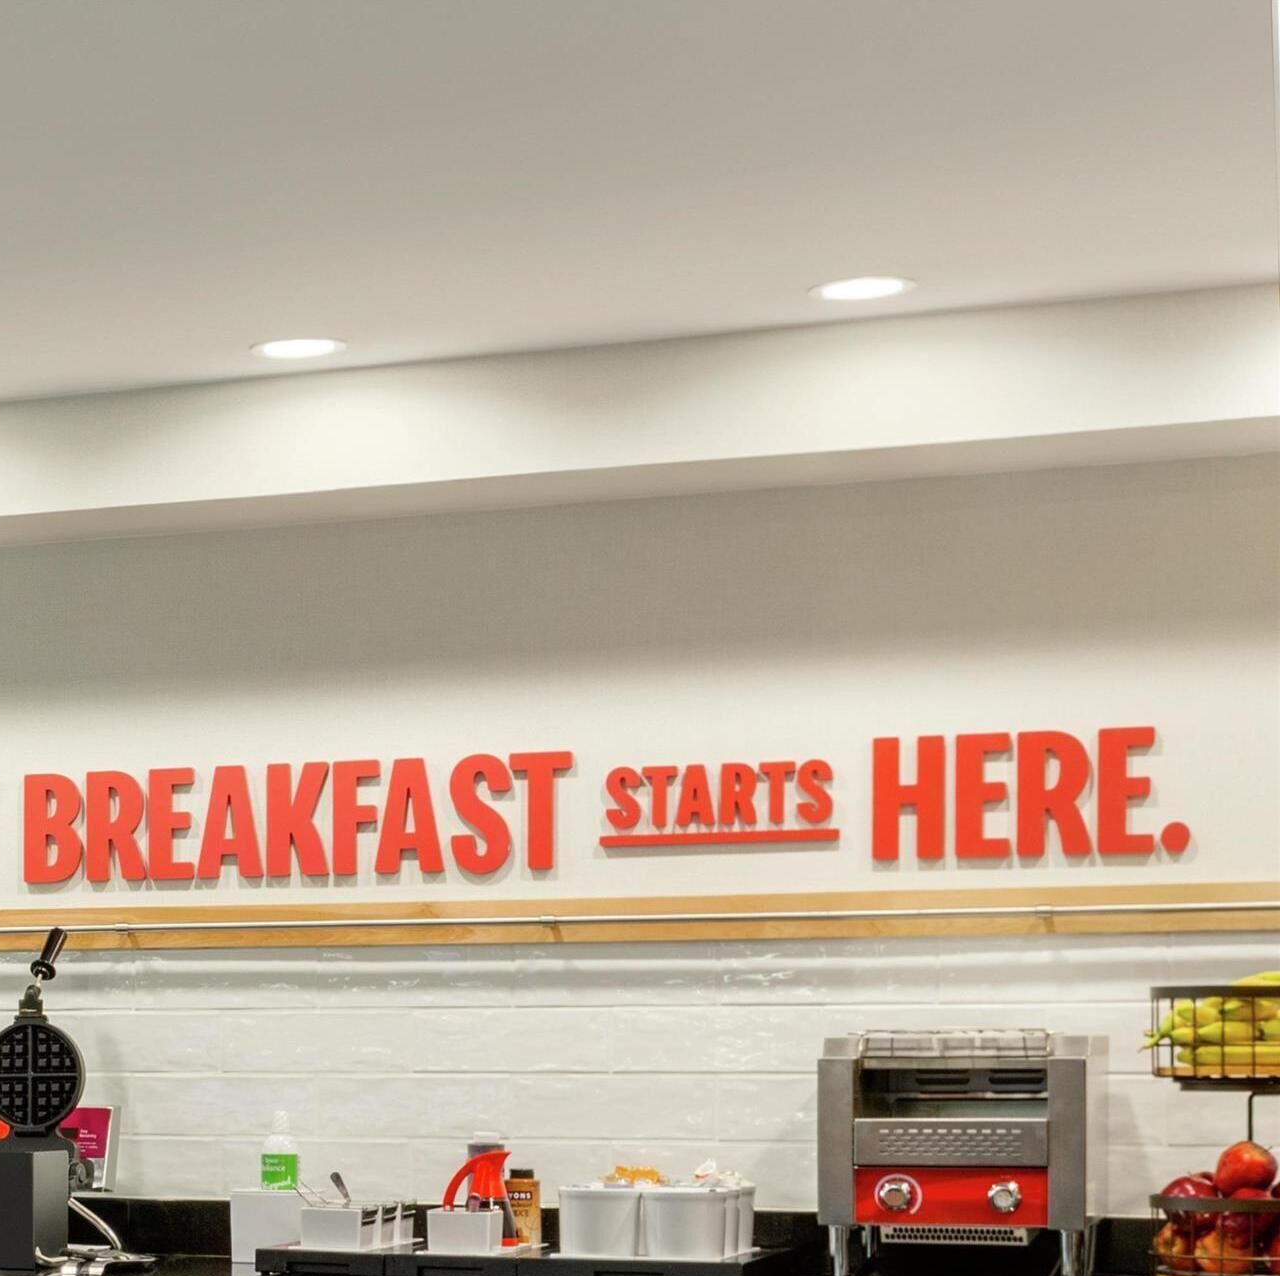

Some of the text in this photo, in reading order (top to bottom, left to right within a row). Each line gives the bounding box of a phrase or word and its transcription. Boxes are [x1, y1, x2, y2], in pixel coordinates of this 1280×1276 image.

[23, 751, 573, 884] BREAKFAST
[598, 761, 834, 829] STARTS
[871, 726, 1189, 861] HERE.
[508, 1191, 531, 1199] YONS
